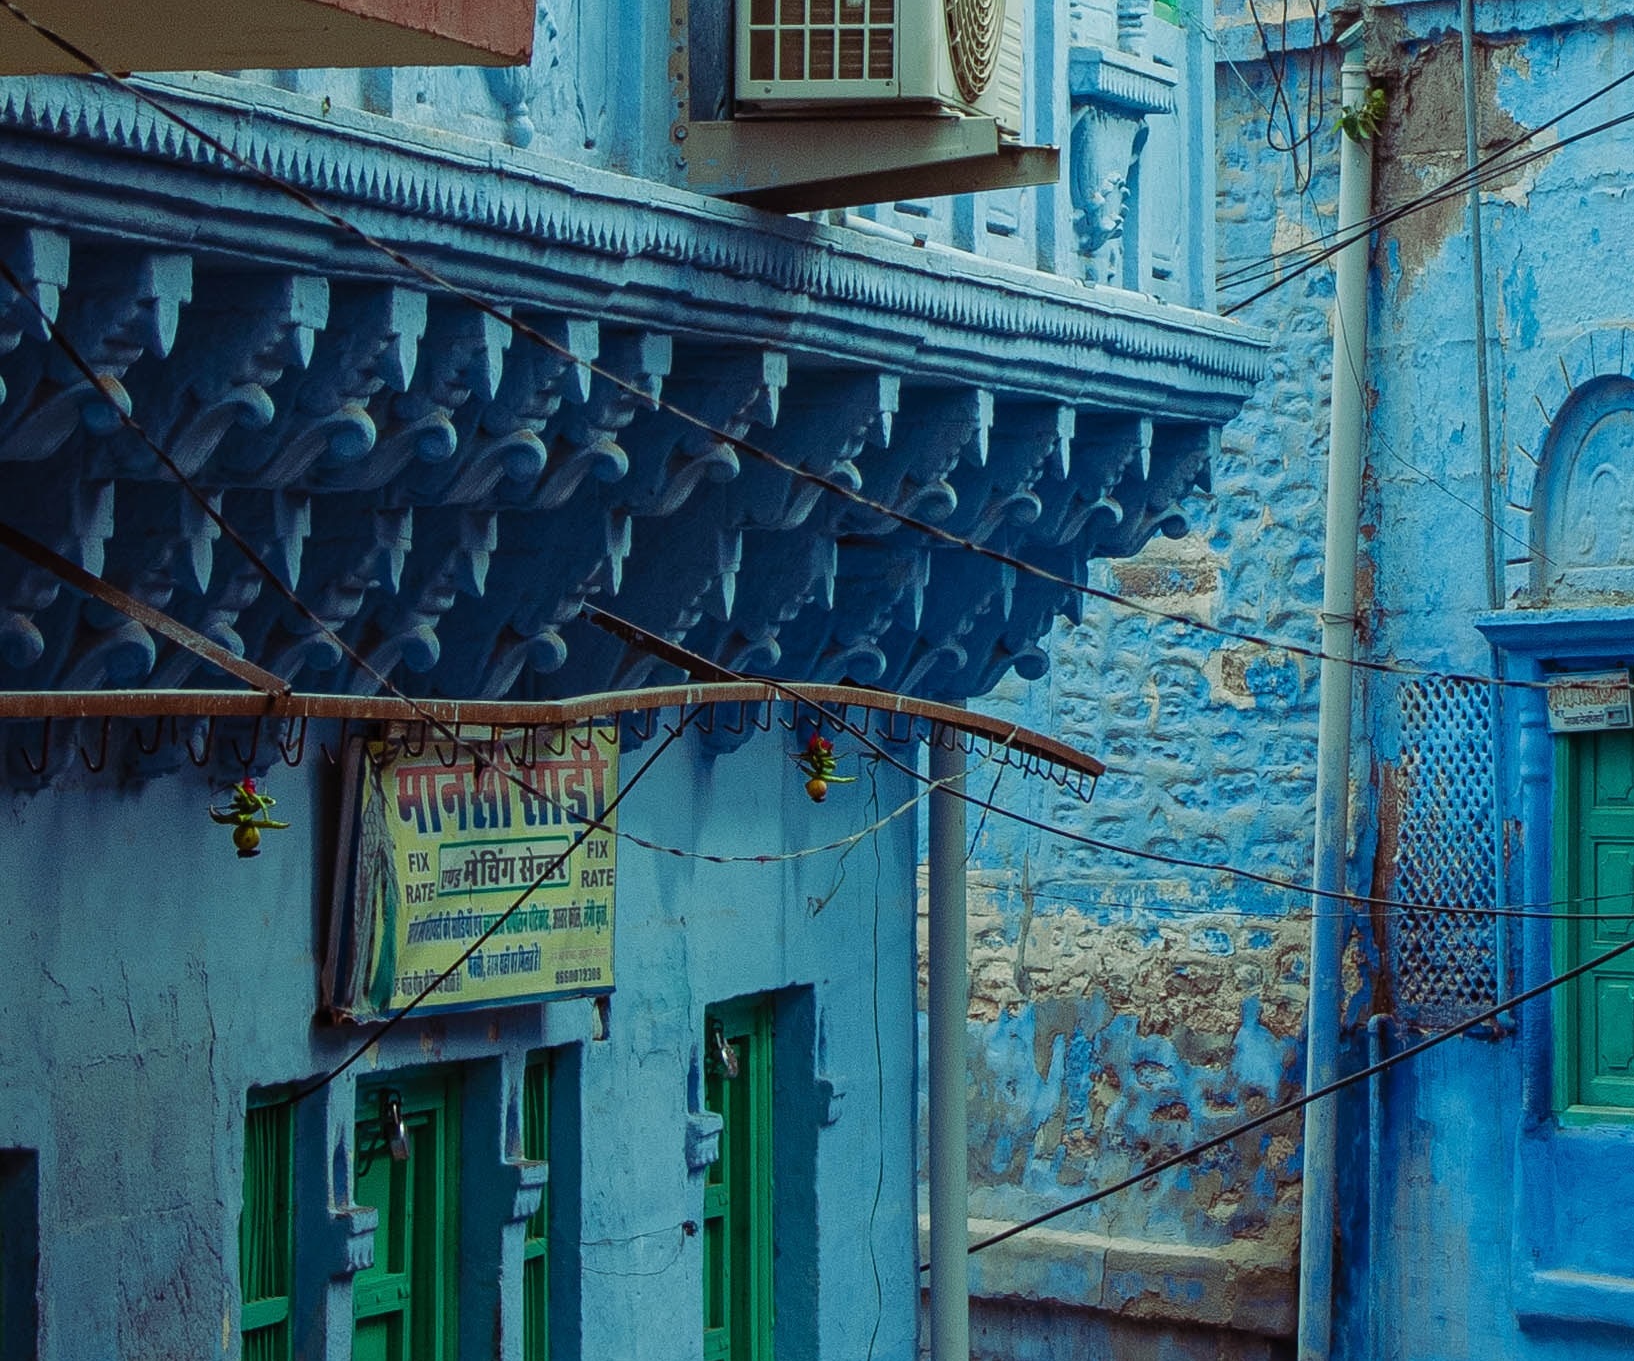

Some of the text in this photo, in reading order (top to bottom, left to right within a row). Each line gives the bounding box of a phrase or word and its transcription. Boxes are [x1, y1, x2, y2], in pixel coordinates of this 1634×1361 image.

[586, 840, 609, 859] FIX
[408, 852, 430, 873] FIX
[581, 868, 614, 887] RATE
[406, 882, 435, 904] RATE
